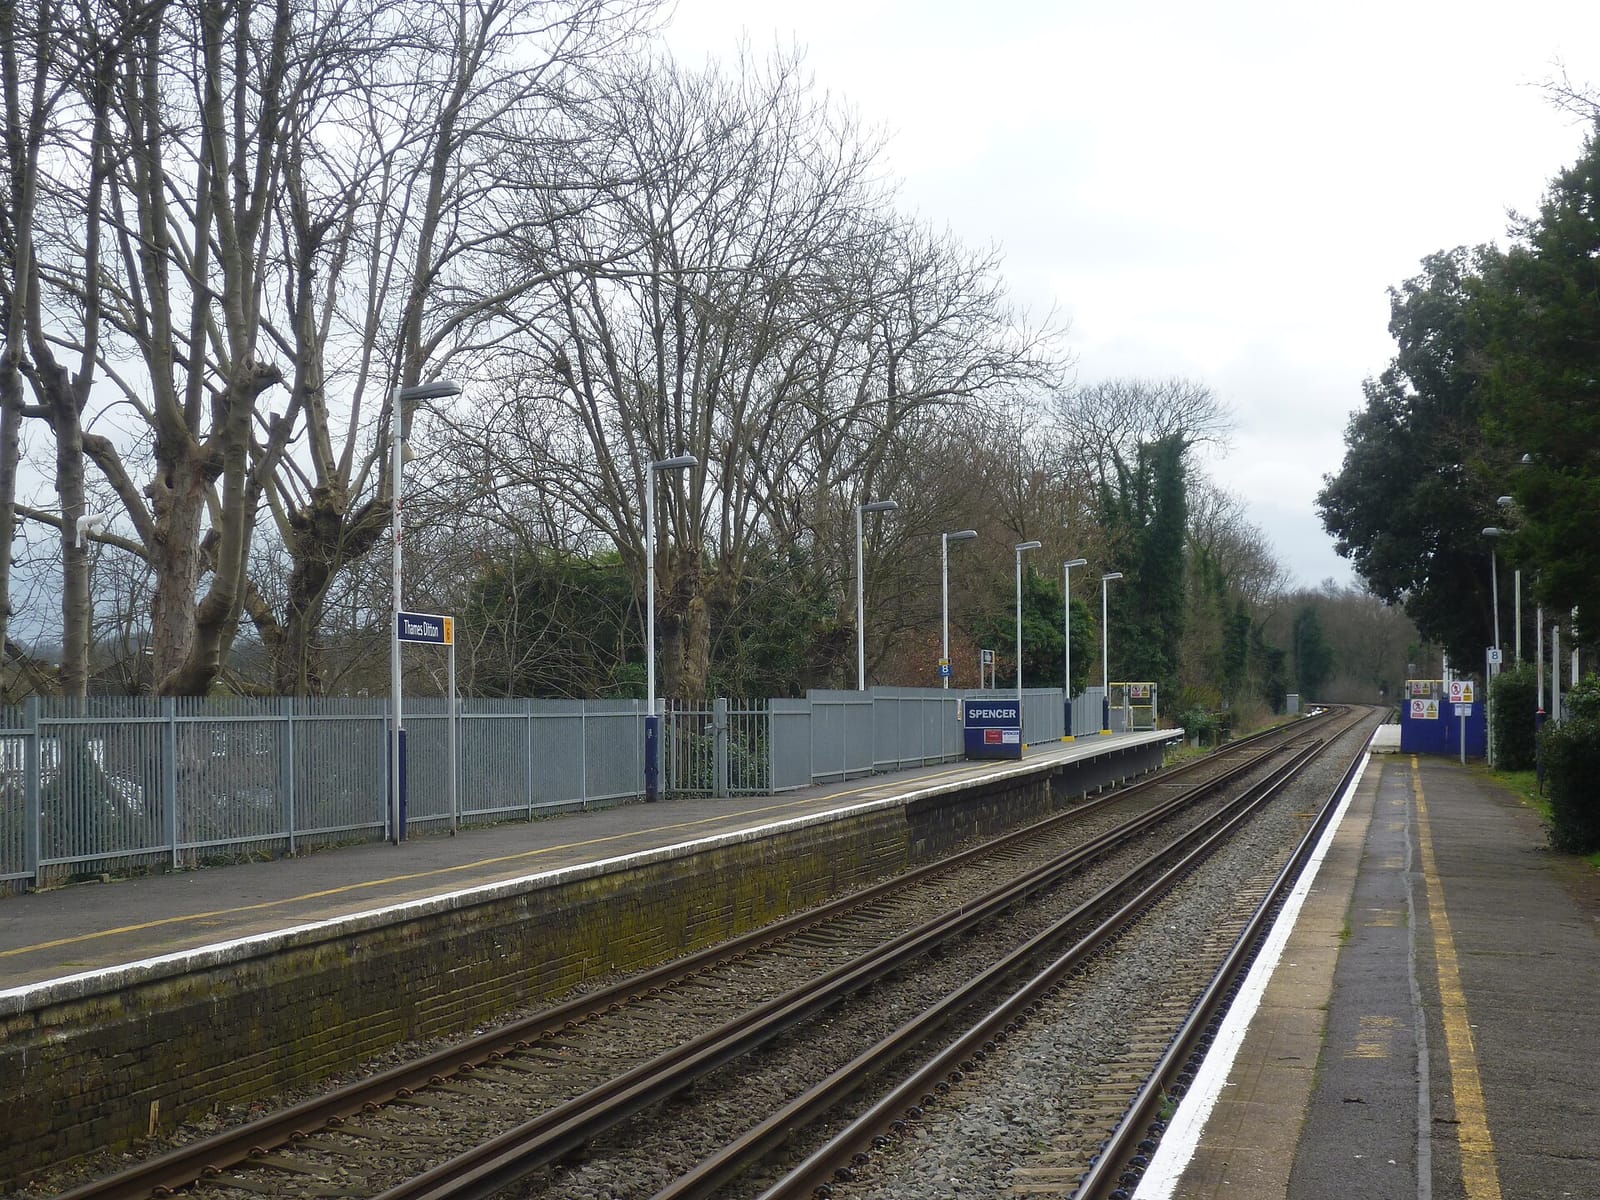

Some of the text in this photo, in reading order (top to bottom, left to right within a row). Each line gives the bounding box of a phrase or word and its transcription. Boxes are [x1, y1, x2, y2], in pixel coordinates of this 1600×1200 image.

[403, 619, 439, 637] Thames Ditton
[1492, 651, 1498, 660] 8
[969, 709, 1016, 719] SPENCER
